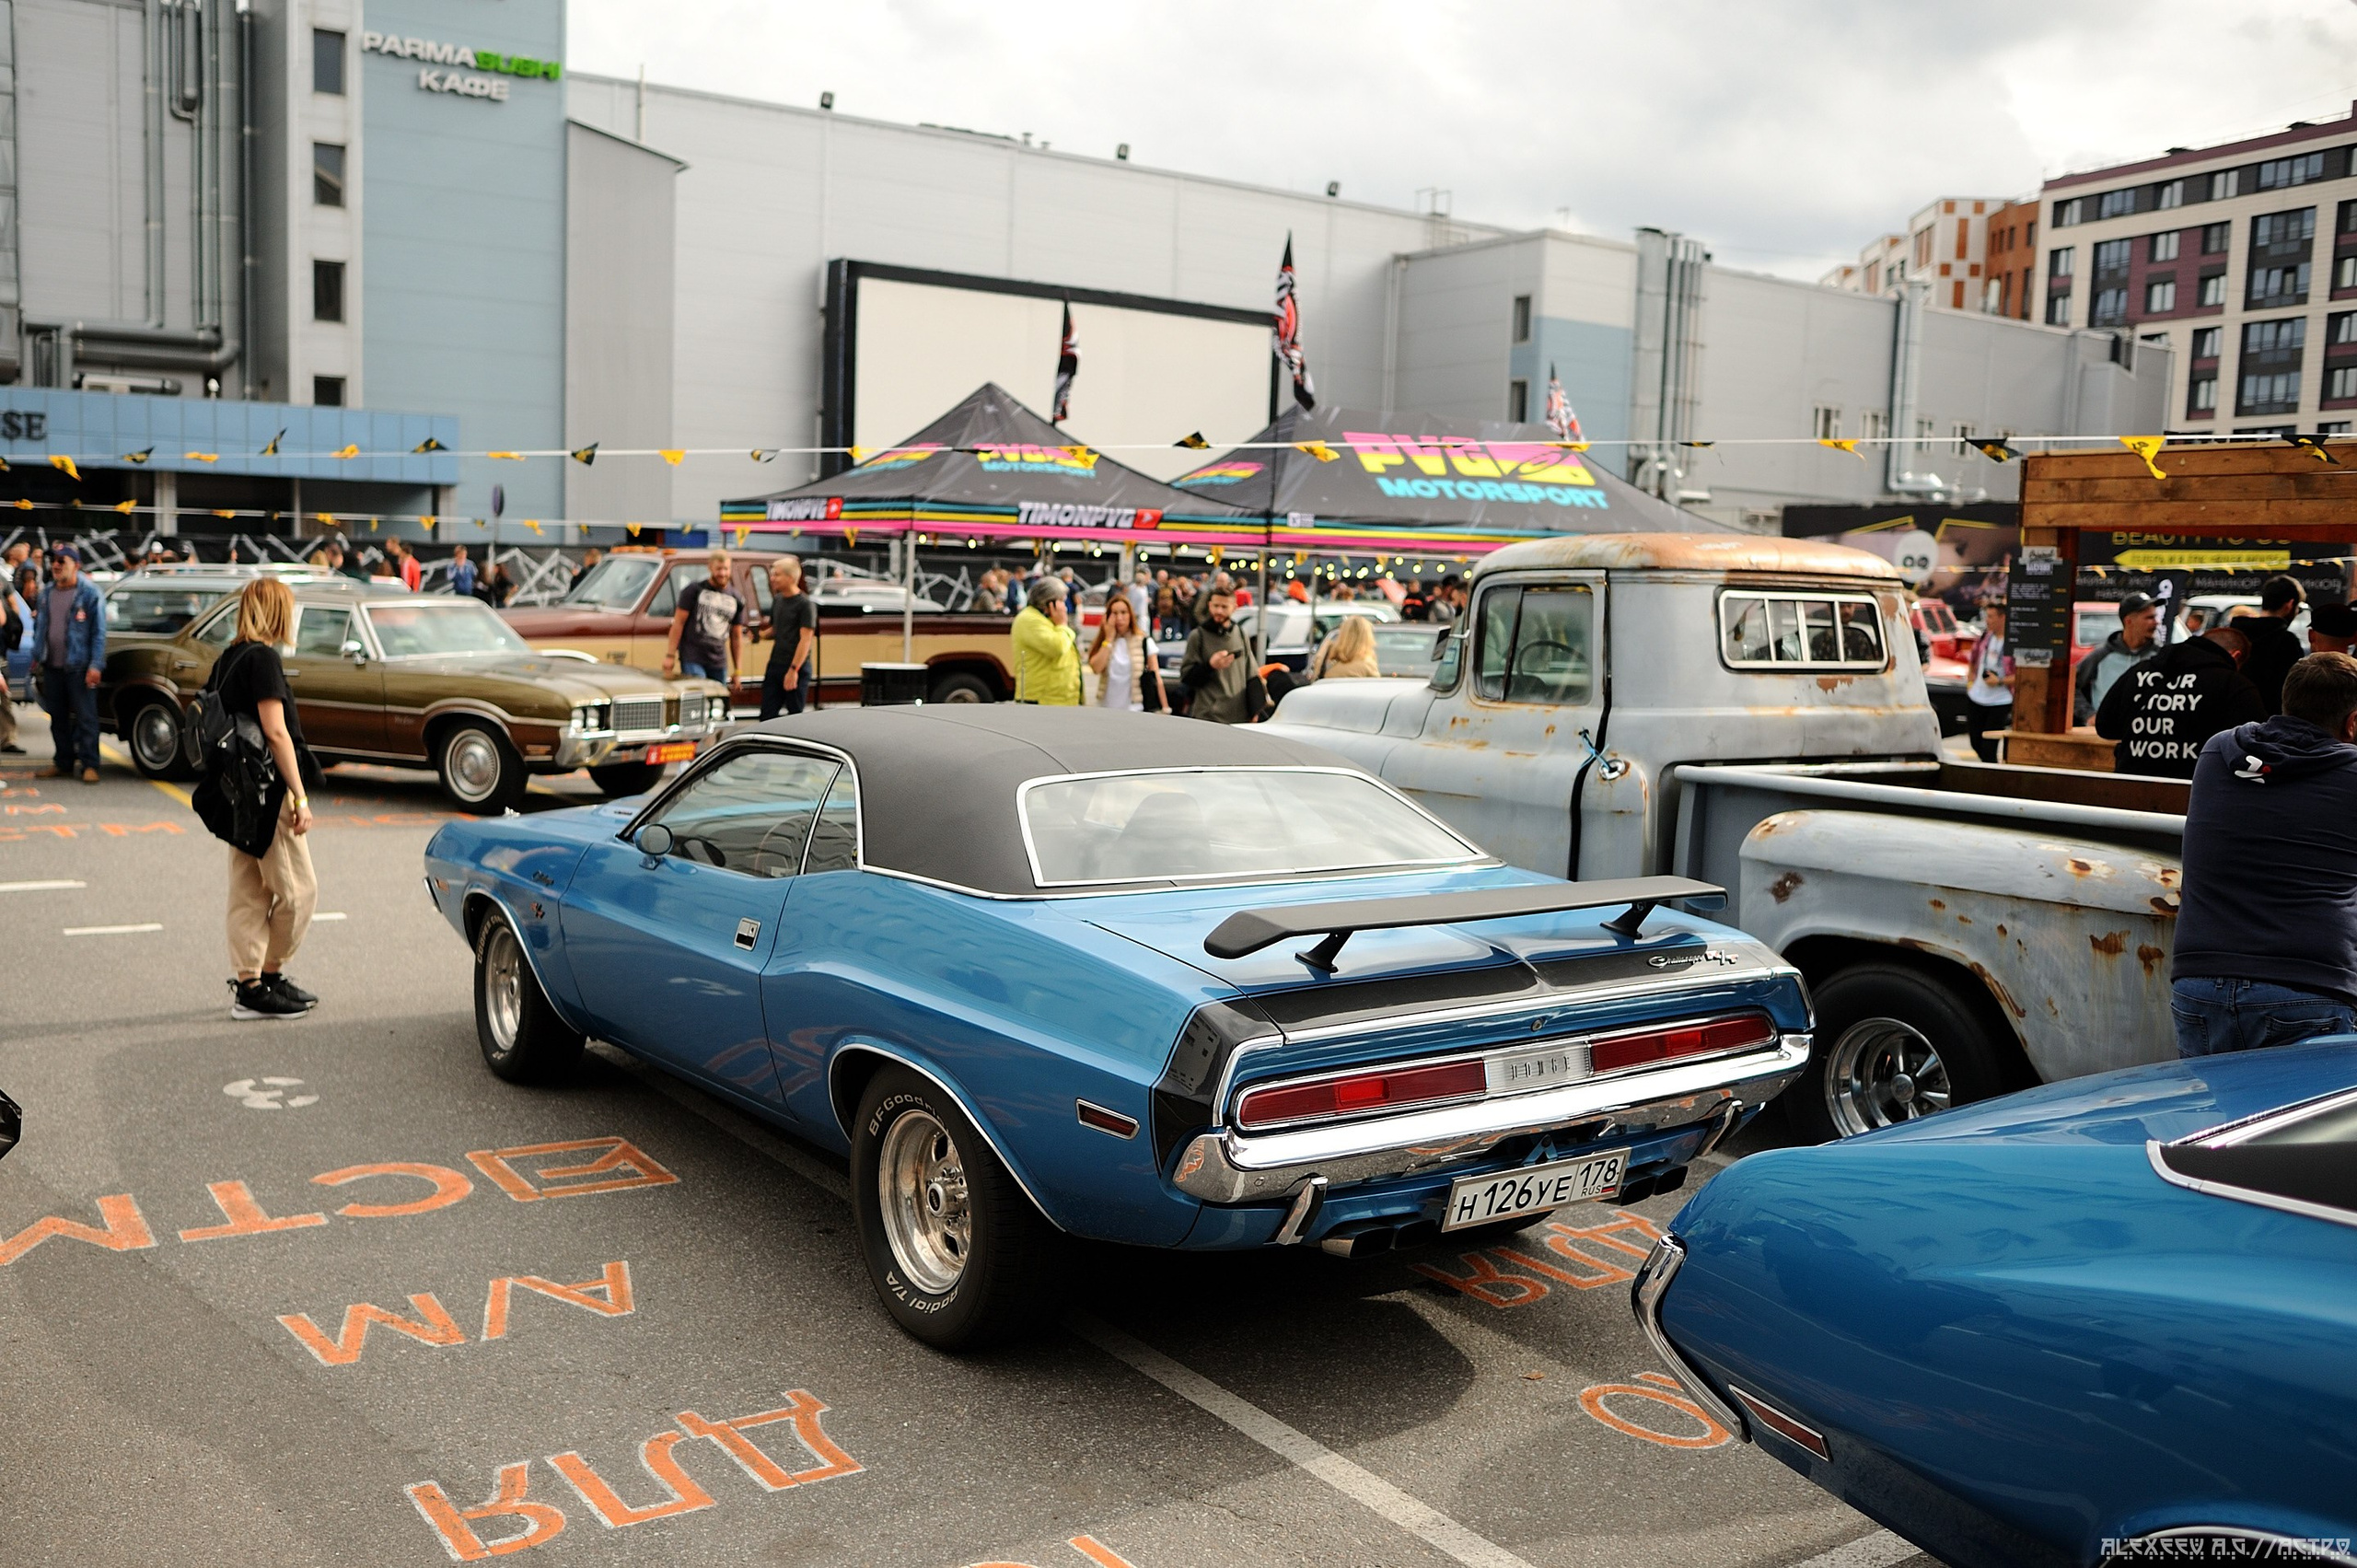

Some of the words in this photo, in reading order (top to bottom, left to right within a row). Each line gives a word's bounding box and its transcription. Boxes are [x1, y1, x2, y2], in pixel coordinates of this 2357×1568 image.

[419, 67, 509, 101] КАФЕ
[1376, 476, 1609, 511] MOTORSPORT
[1017, 502, 1135, 528] TIMONPVG
[2136, 671, 2197, 690] YOUR
[2131, 717, 2175, 735] OUR
[2130, 740, 2198, 759] WORK
[1510, 1055, 1572, 1081] DODGE
[868, 1093, 949, 1137] BFGoodric
[1580, 1157, 1619, 1188] 178
[1581, 1185, 1602, 1197] RUS
[885, 1271, 908, 1301] T/A
[403, 1388, 866, 1562] ДЛЯ
